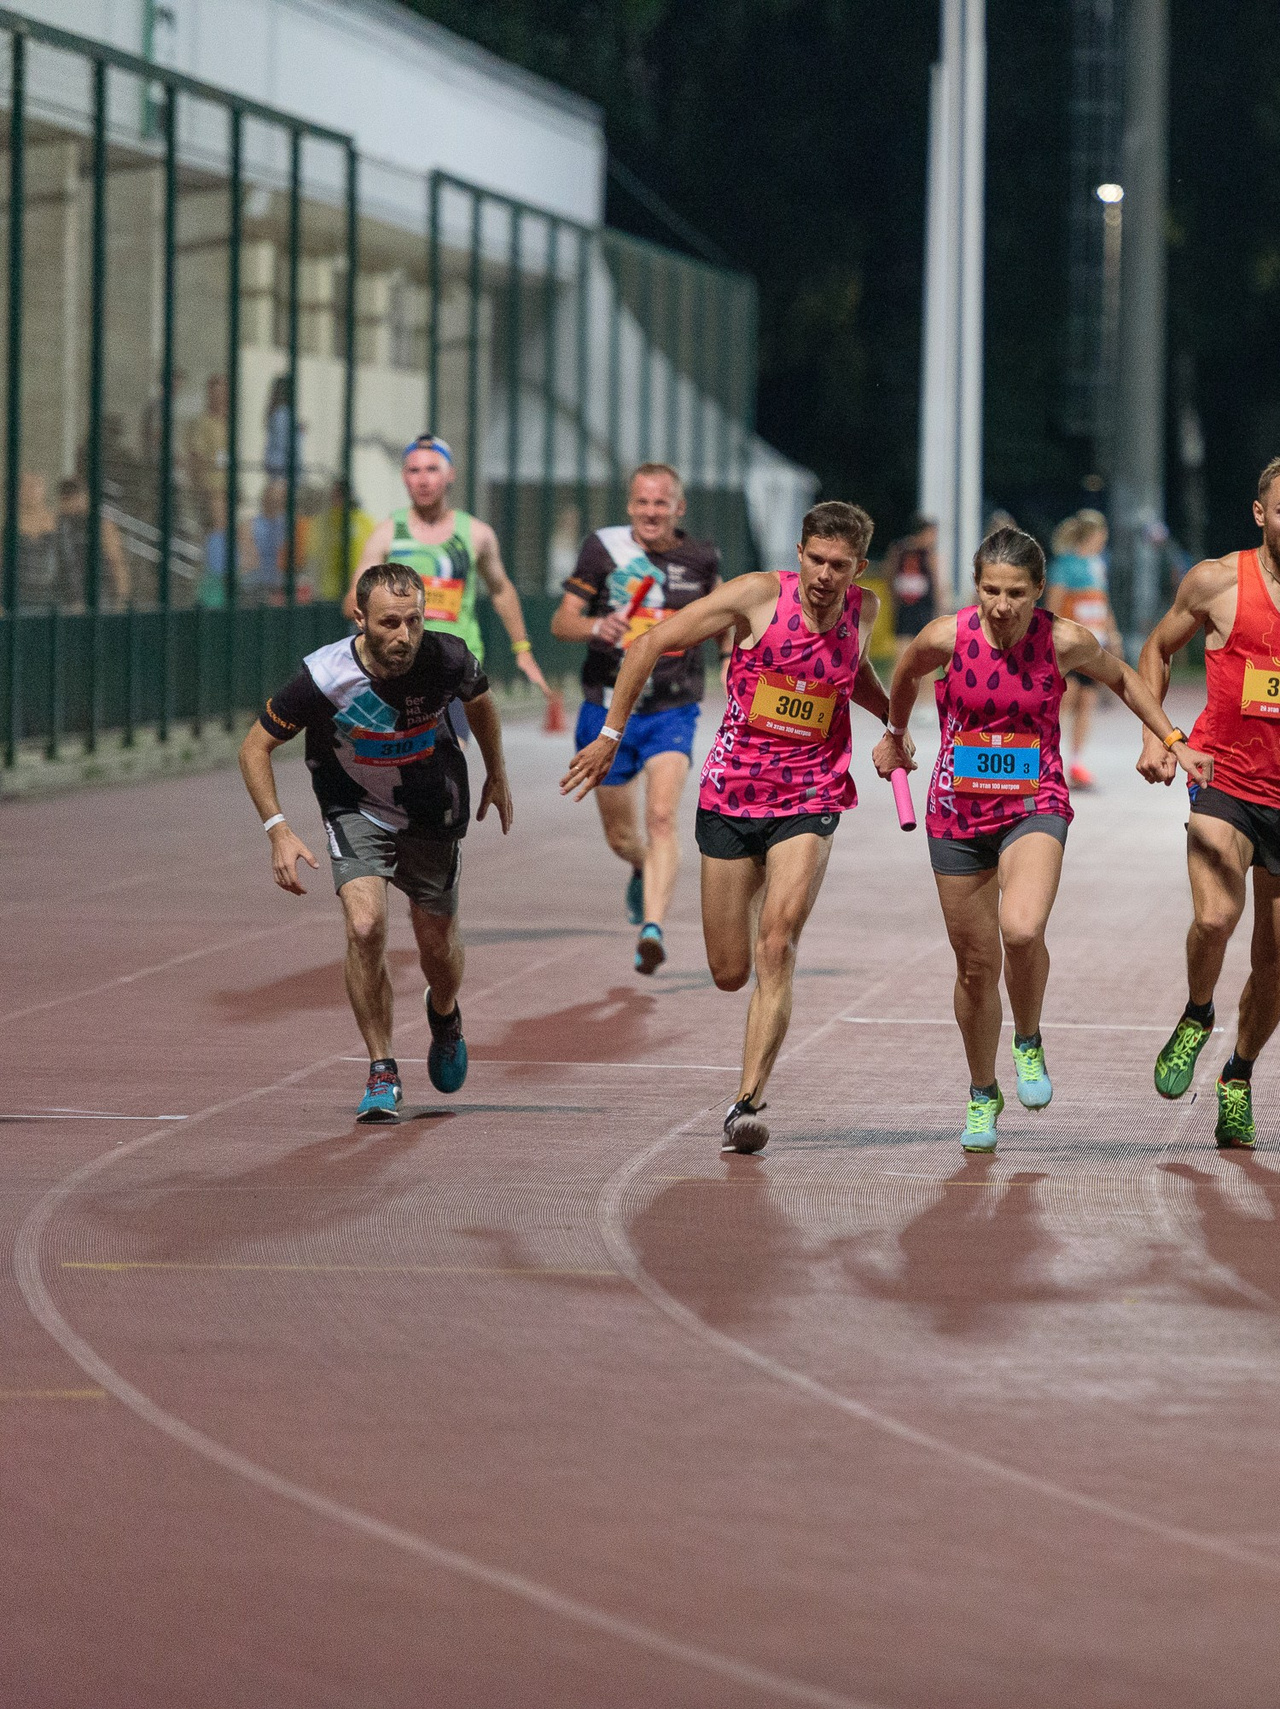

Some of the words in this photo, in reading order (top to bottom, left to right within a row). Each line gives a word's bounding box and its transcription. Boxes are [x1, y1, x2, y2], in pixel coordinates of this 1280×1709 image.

[405, 696, 426, 706] бег
[406, 706, 421, 716] на
[776, 695, 814, 720] 309
[817, 712, 825, 723] 2
[794, 728, 812, 737] метров
[381, 741, 413, 755] 310
[977, 753, 1015, 774] 309
[1023, 763, 1030, 774] 3
